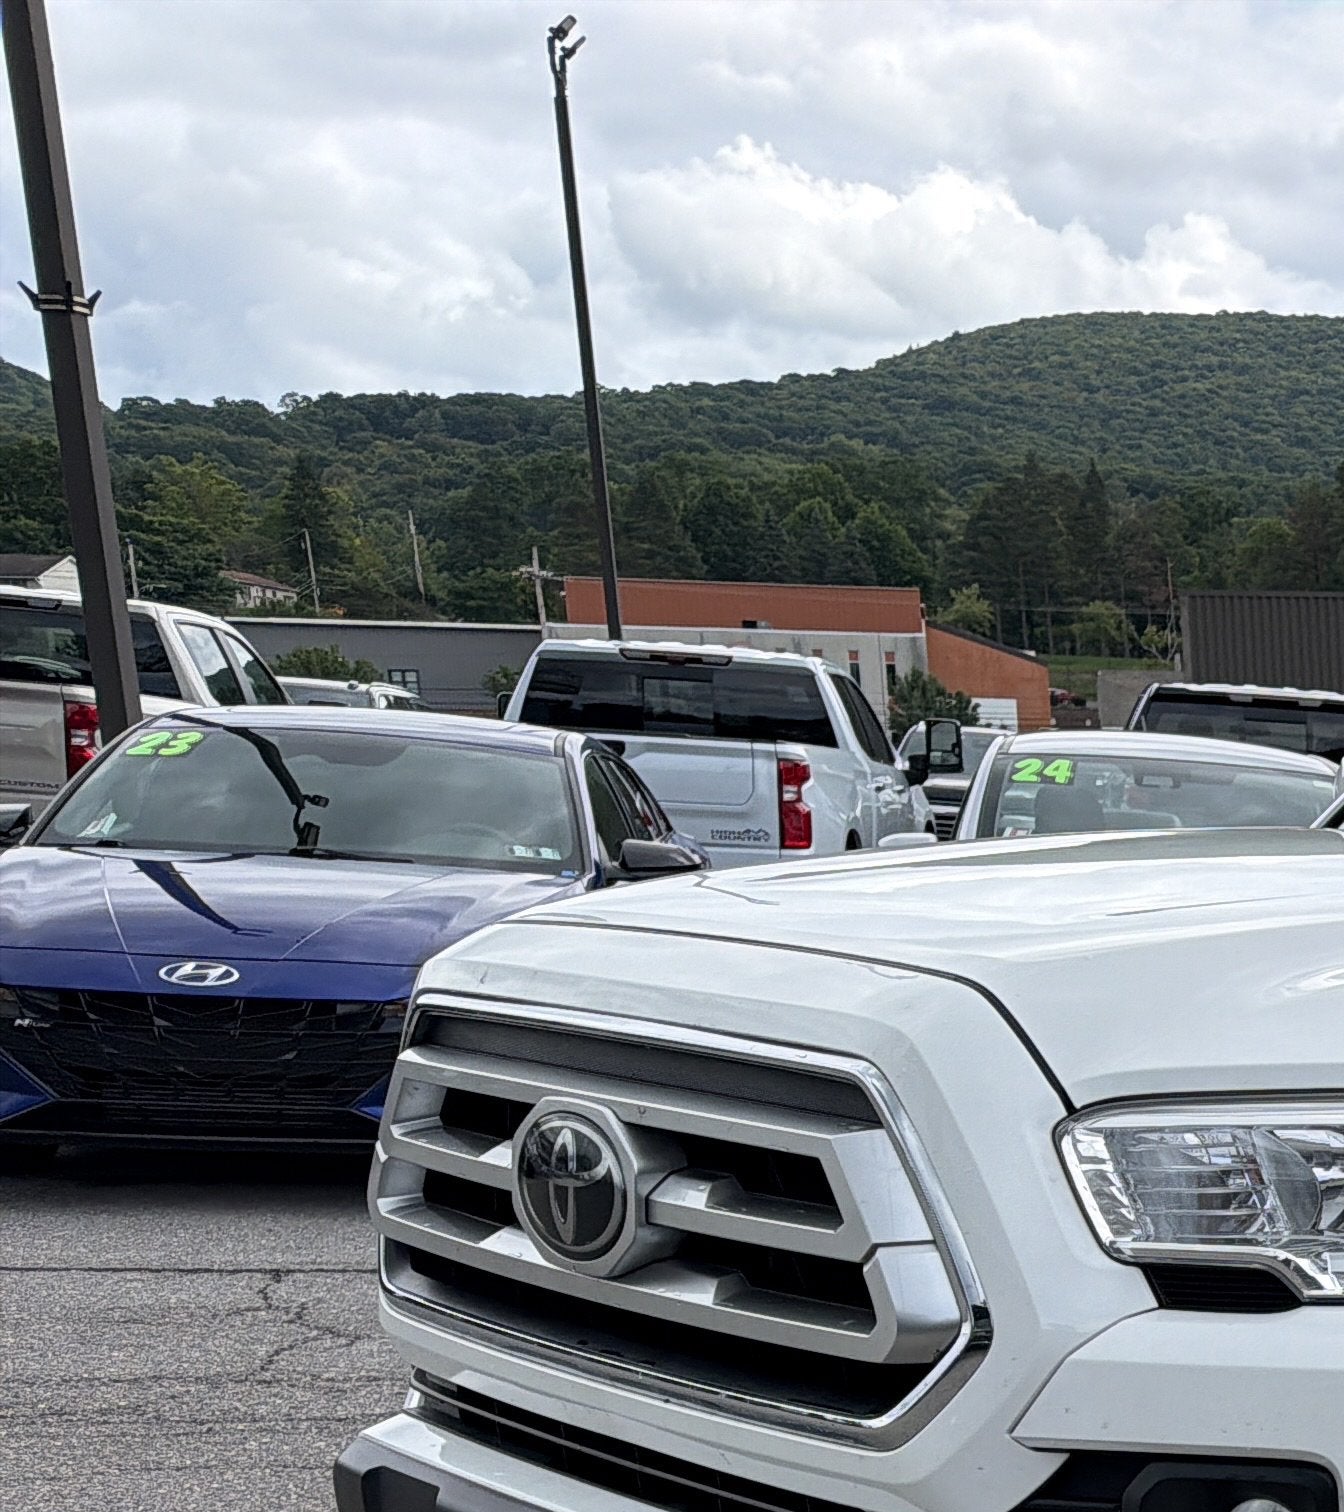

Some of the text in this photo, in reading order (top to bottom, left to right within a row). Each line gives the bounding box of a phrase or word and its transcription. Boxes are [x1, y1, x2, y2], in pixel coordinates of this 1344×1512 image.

[126, 731, 204, 757] 23
[1011, 758, 1073, 784] 24
[0, 780, 60, 789] CUSTOM
